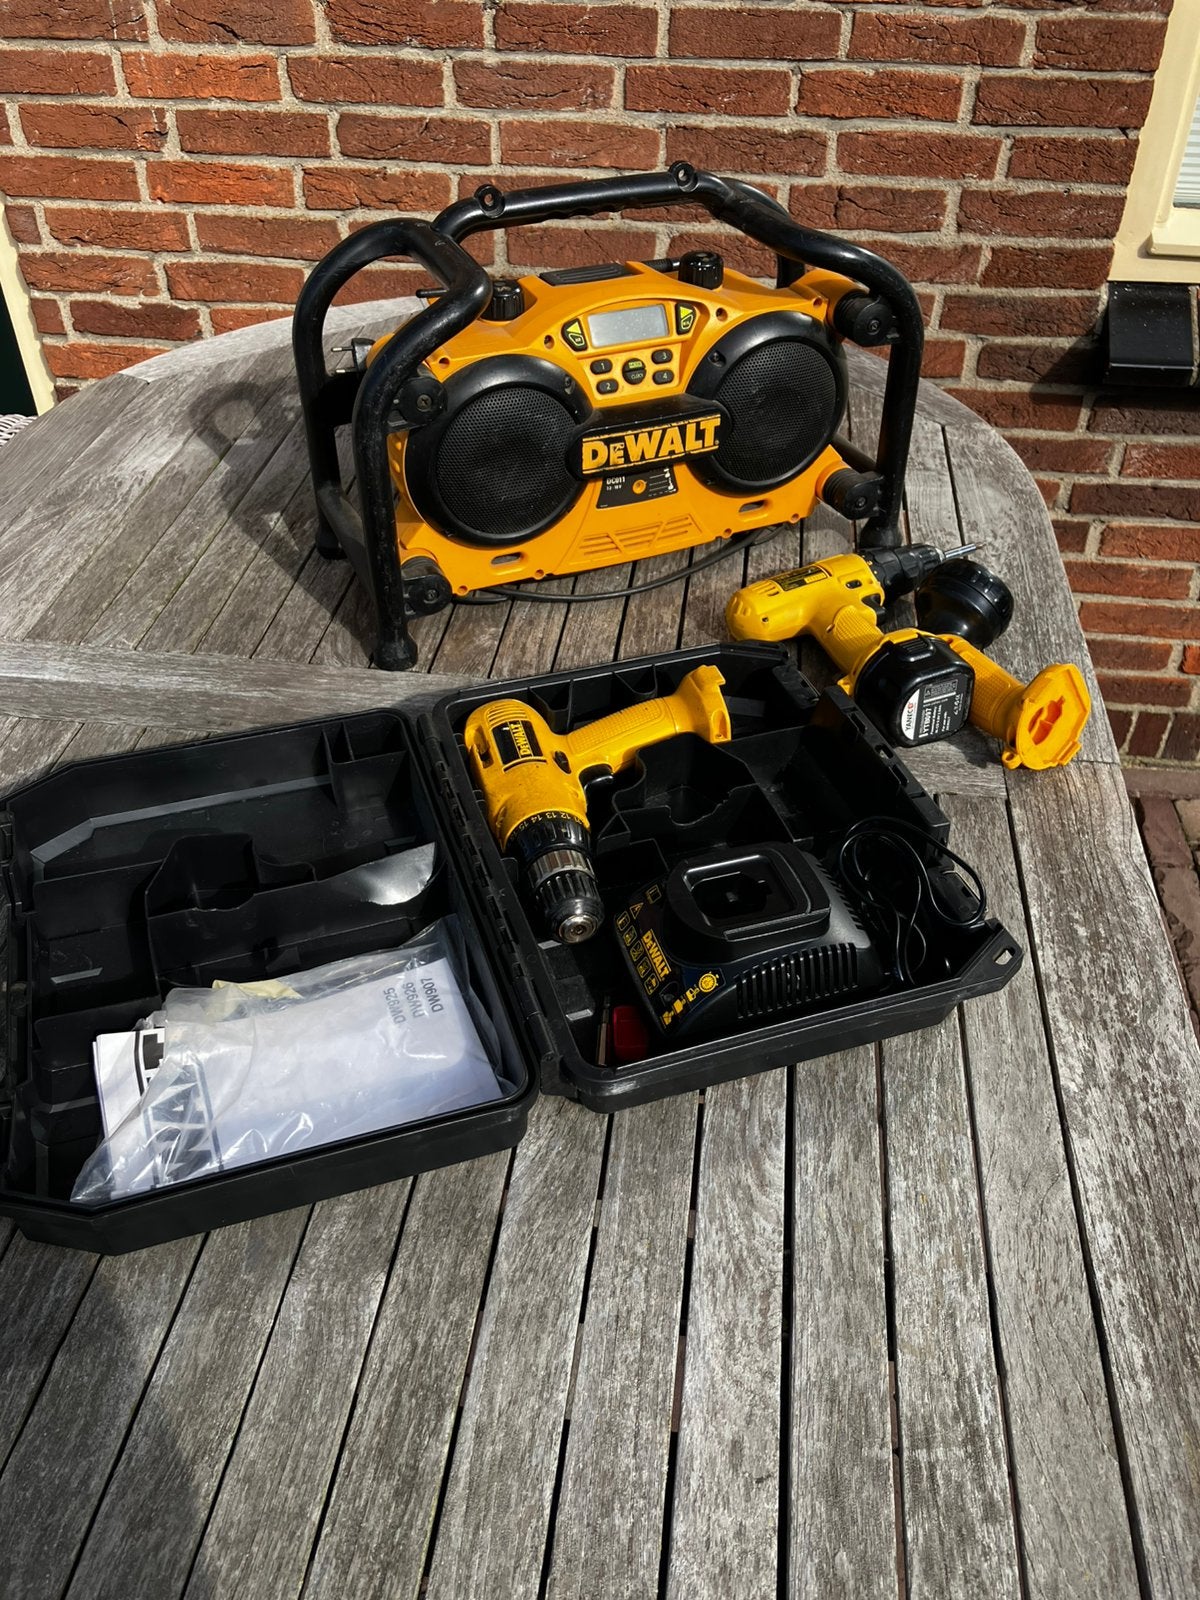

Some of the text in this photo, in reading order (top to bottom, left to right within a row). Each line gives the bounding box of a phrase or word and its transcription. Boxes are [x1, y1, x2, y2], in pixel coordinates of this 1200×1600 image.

[582, 417, 721, 471] DEWALT
[510, 723, 531, 756] DEWALT
[531, 814, 543, 823] 14
[561, 812, 571, 820] 12
[642, 930, 669, 979] DEWALT
[383, 987, 406, 1024] DW925
[402, 982, 426, 1018] DW926
[421, 978, 444, 1013] DW907
